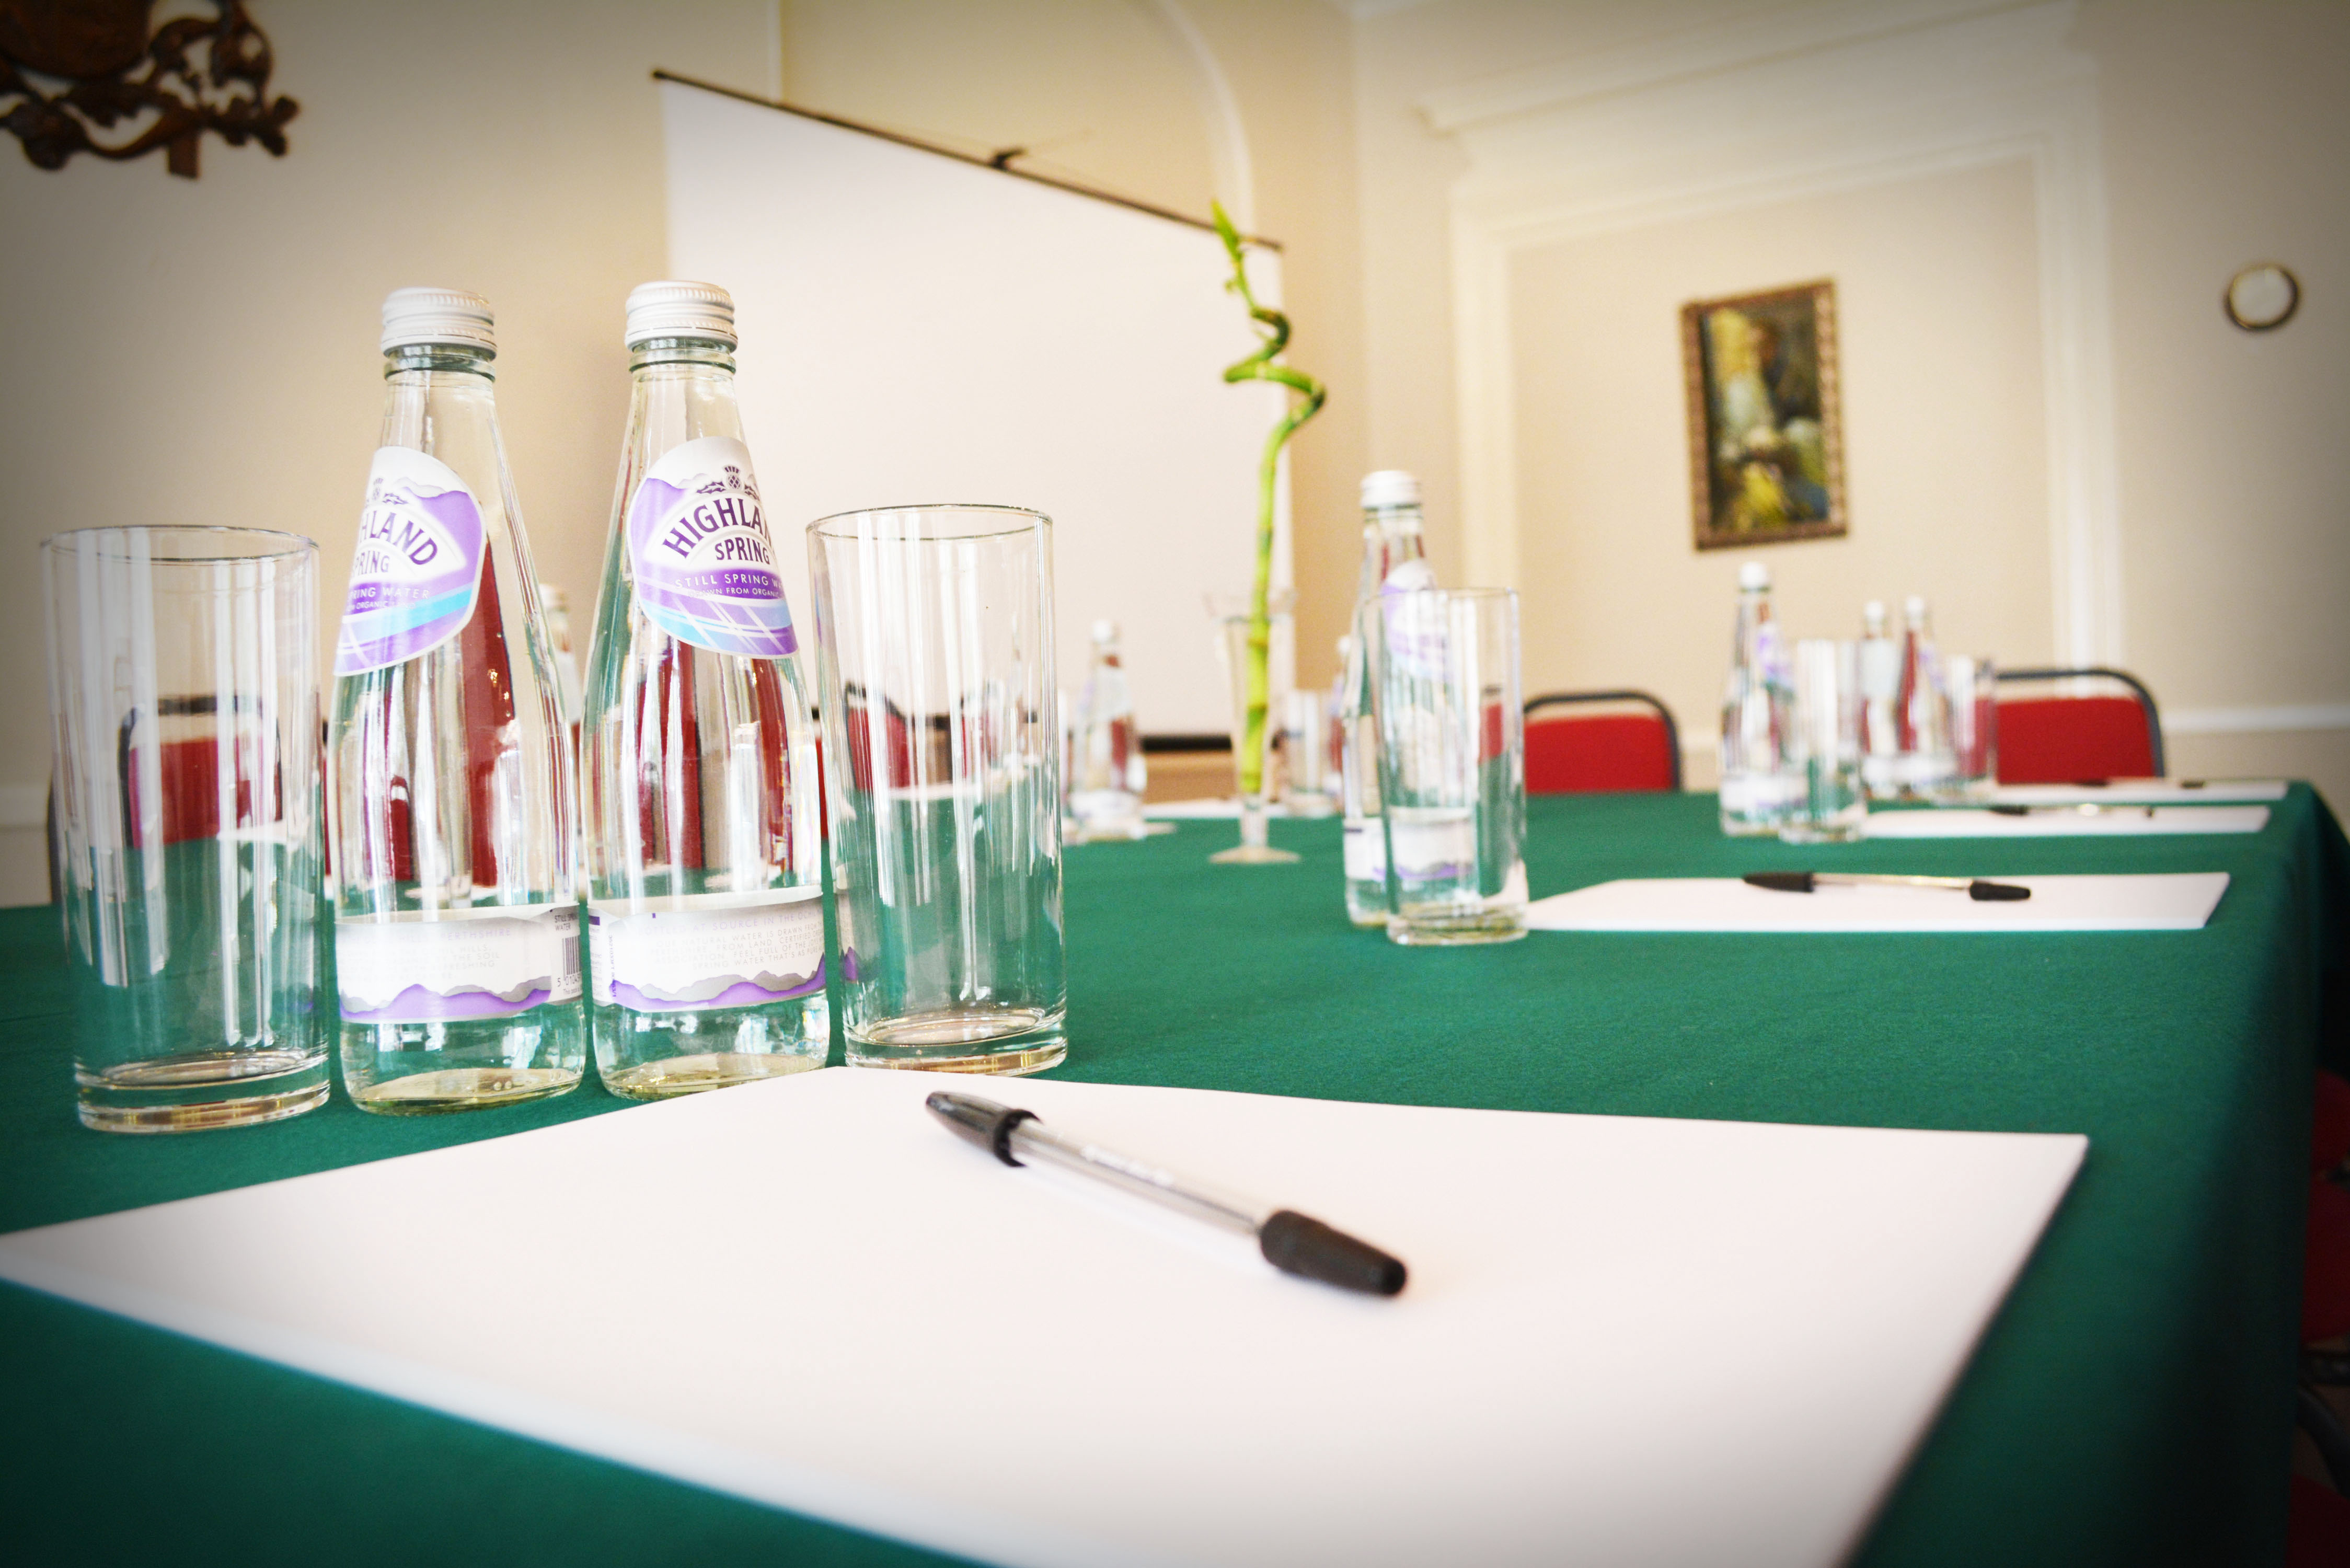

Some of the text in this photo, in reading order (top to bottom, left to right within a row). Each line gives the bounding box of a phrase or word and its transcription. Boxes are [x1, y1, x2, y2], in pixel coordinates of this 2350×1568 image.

[663, 498, 773, 559] HIGHLAN
[715, 537, 770, 566] SPRING
[675, 574, 718, 589] STILL
[724, 574, 769, 586] SPRING
[383, 586, 430, 599] WATER
[726, 587, 749, 595] FROM
[693, 923, 706, 932] AT
[712, 918, 758, 931] SOURCE
[764, 916, 774, 926] IN
[779, 915, 794, 924] THE
[442, 927, 511, 941] PERTHSHIRE
[732, 932, 762, 941] WATER
[777, 926, 802, 937] DRAWN
[717, 943, 744, 952] FROM
[748, 939, 773, 949] LAND
[733, 950, 755, 958] FEEL
[759, 947, 778, 955] FULL
[782, 944, 792, 952] OF
[734, 956, 765, 966] WATER
[769, 952, 795, 962] THAT'S
